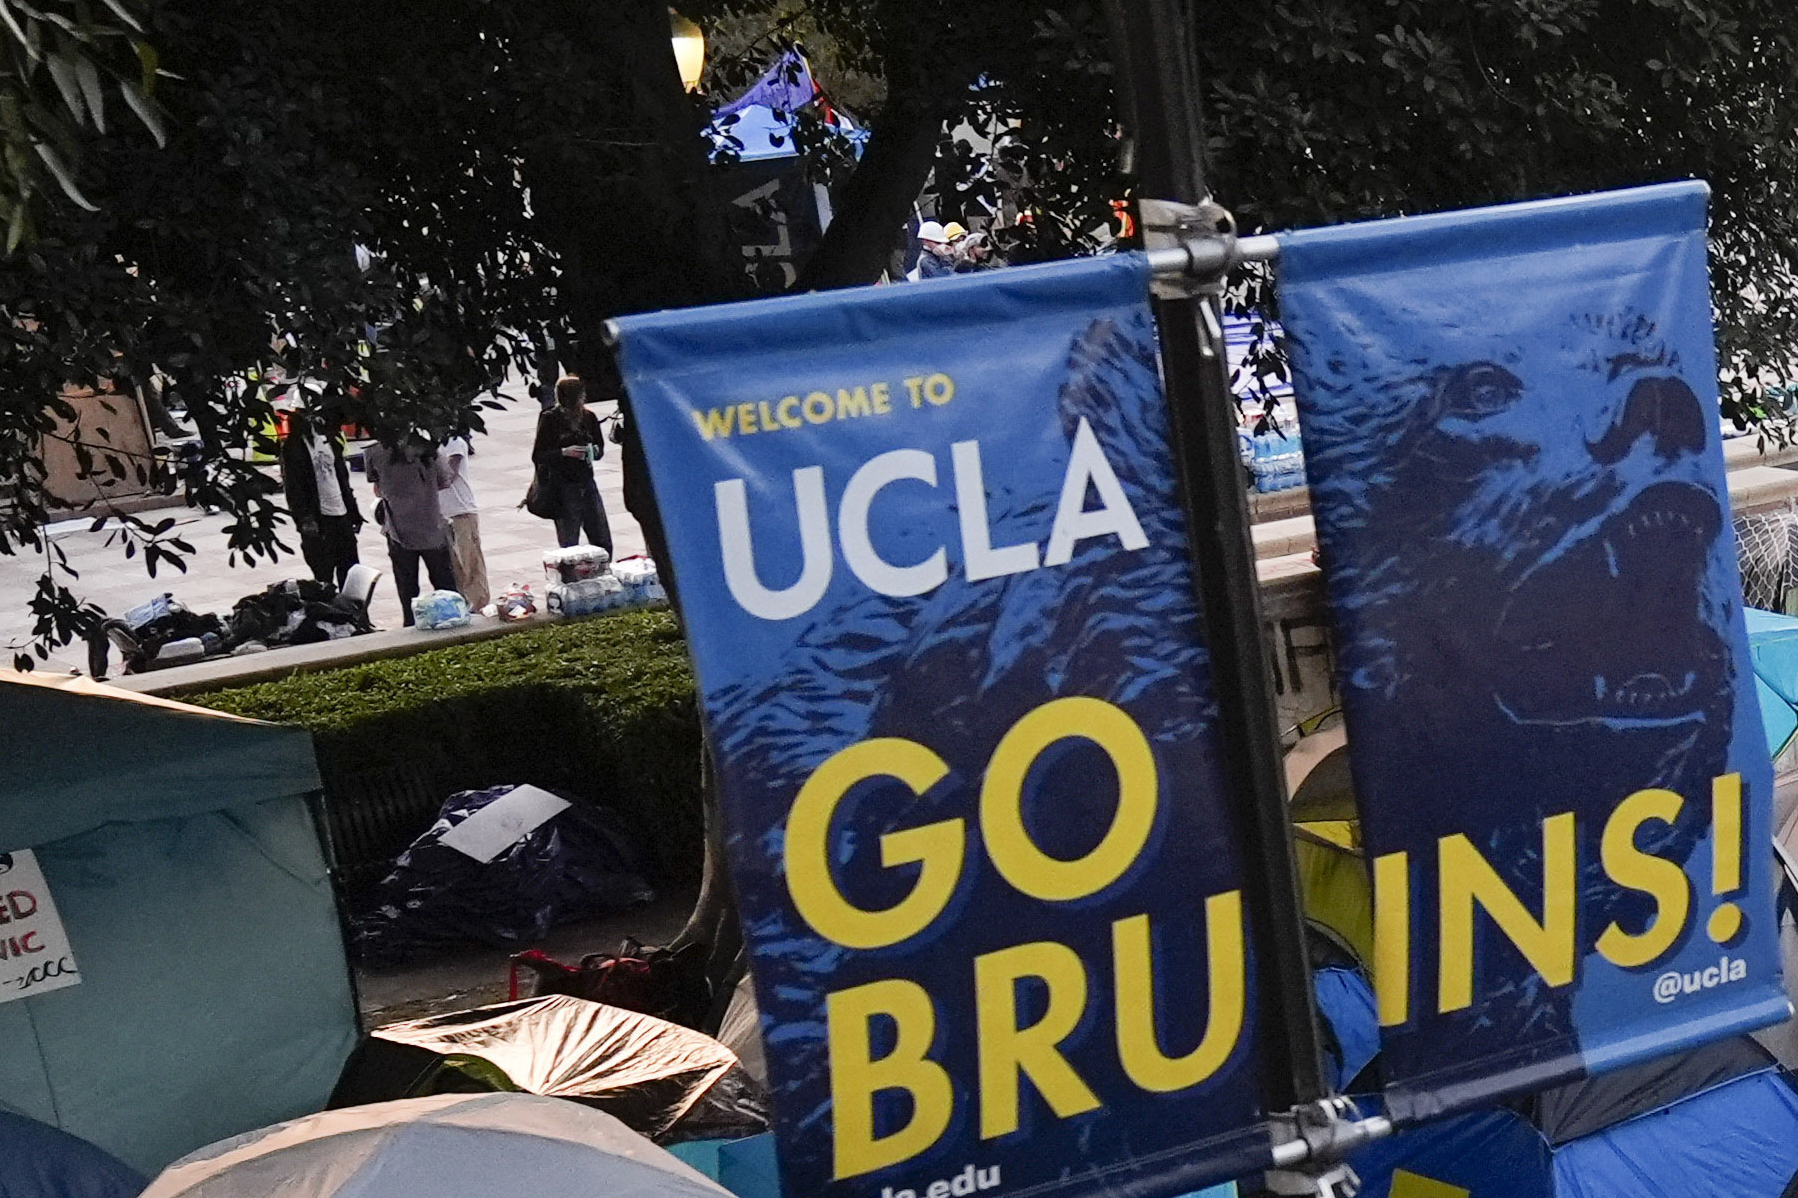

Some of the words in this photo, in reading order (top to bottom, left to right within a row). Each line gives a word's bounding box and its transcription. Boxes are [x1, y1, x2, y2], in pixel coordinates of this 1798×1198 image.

[693, 382, 892, 442] WELCOME
[903, 373, 954, 407] TO
[714, 414, 1151, 621] UCLA
[786, 696, 1159, 950] GO
[828, 888, 1246, 1181] BRU
[1372, 773, 1743, 1027] INS!
[1652, 955, 1748, 1004] @ucla
